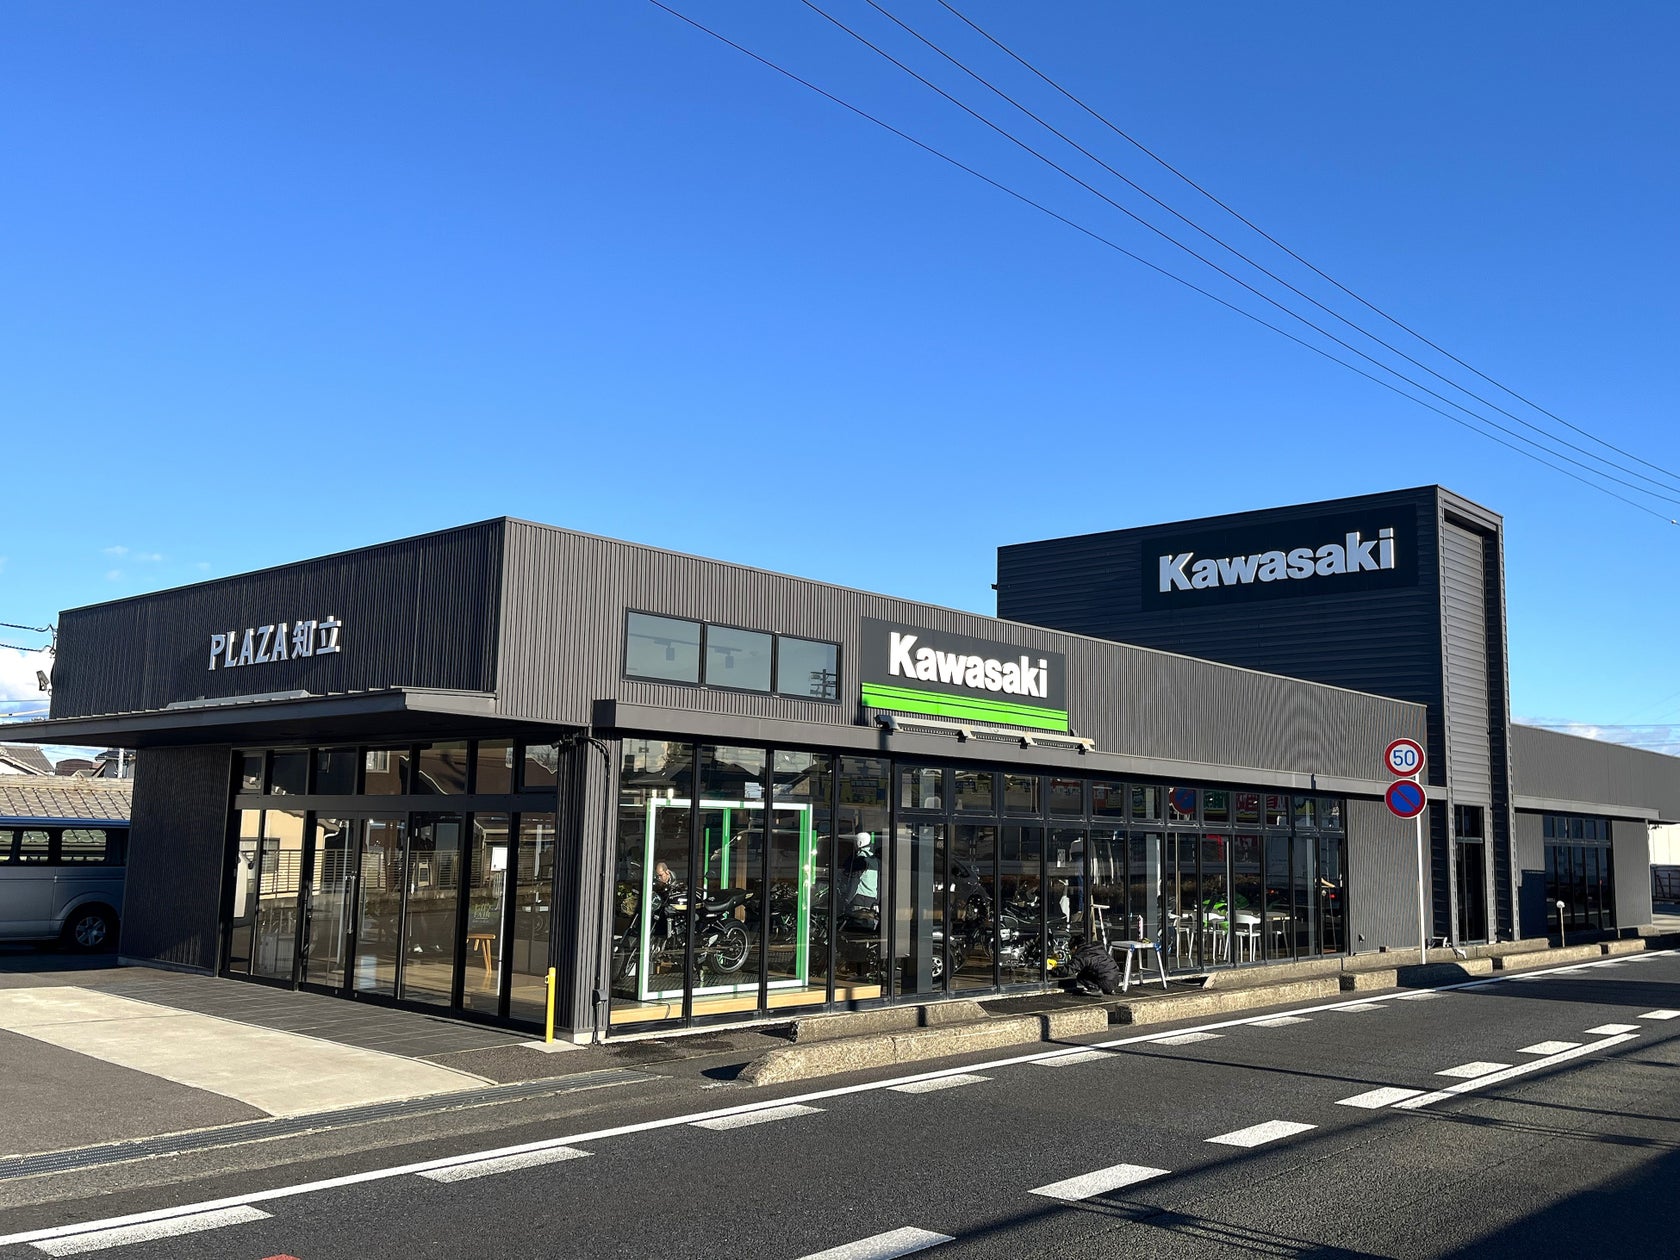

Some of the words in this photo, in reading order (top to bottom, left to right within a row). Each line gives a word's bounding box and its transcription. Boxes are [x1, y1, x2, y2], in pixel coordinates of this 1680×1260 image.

[1159, 527, 1395, 592] Kawasaki
[888, 631, 1048, 699] Kawasaki
[1393, 749, 1416, 767] 50
